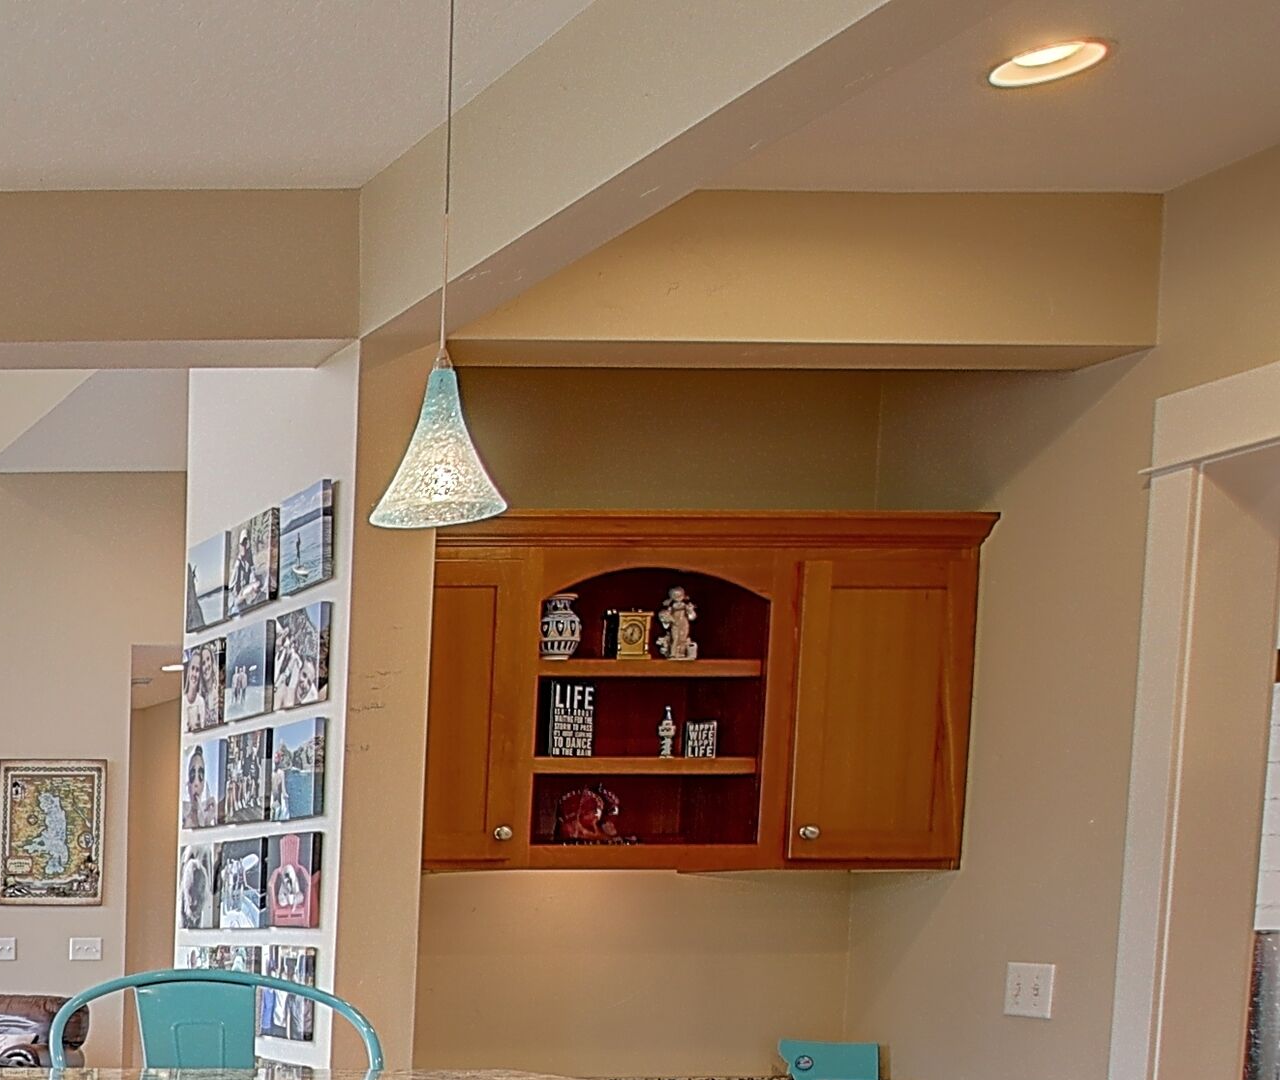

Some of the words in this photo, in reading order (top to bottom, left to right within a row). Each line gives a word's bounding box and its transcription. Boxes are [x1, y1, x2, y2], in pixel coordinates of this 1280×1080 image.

[555, 684, 594, 709] LIFE
[574, 716, 584, 724] FOR
[584, 717, 593, 725] THE
[689, 731, 713, 740] WIFE
[553, 736, 564, 748] TO
[565, 737, 592, 749] DANCE
[552, 747, 560, 755] IN
[561, 748, 573, 756] THE
[576, 749, 592, 757] RAIN
[688, 746, 712, 757] LIFE
